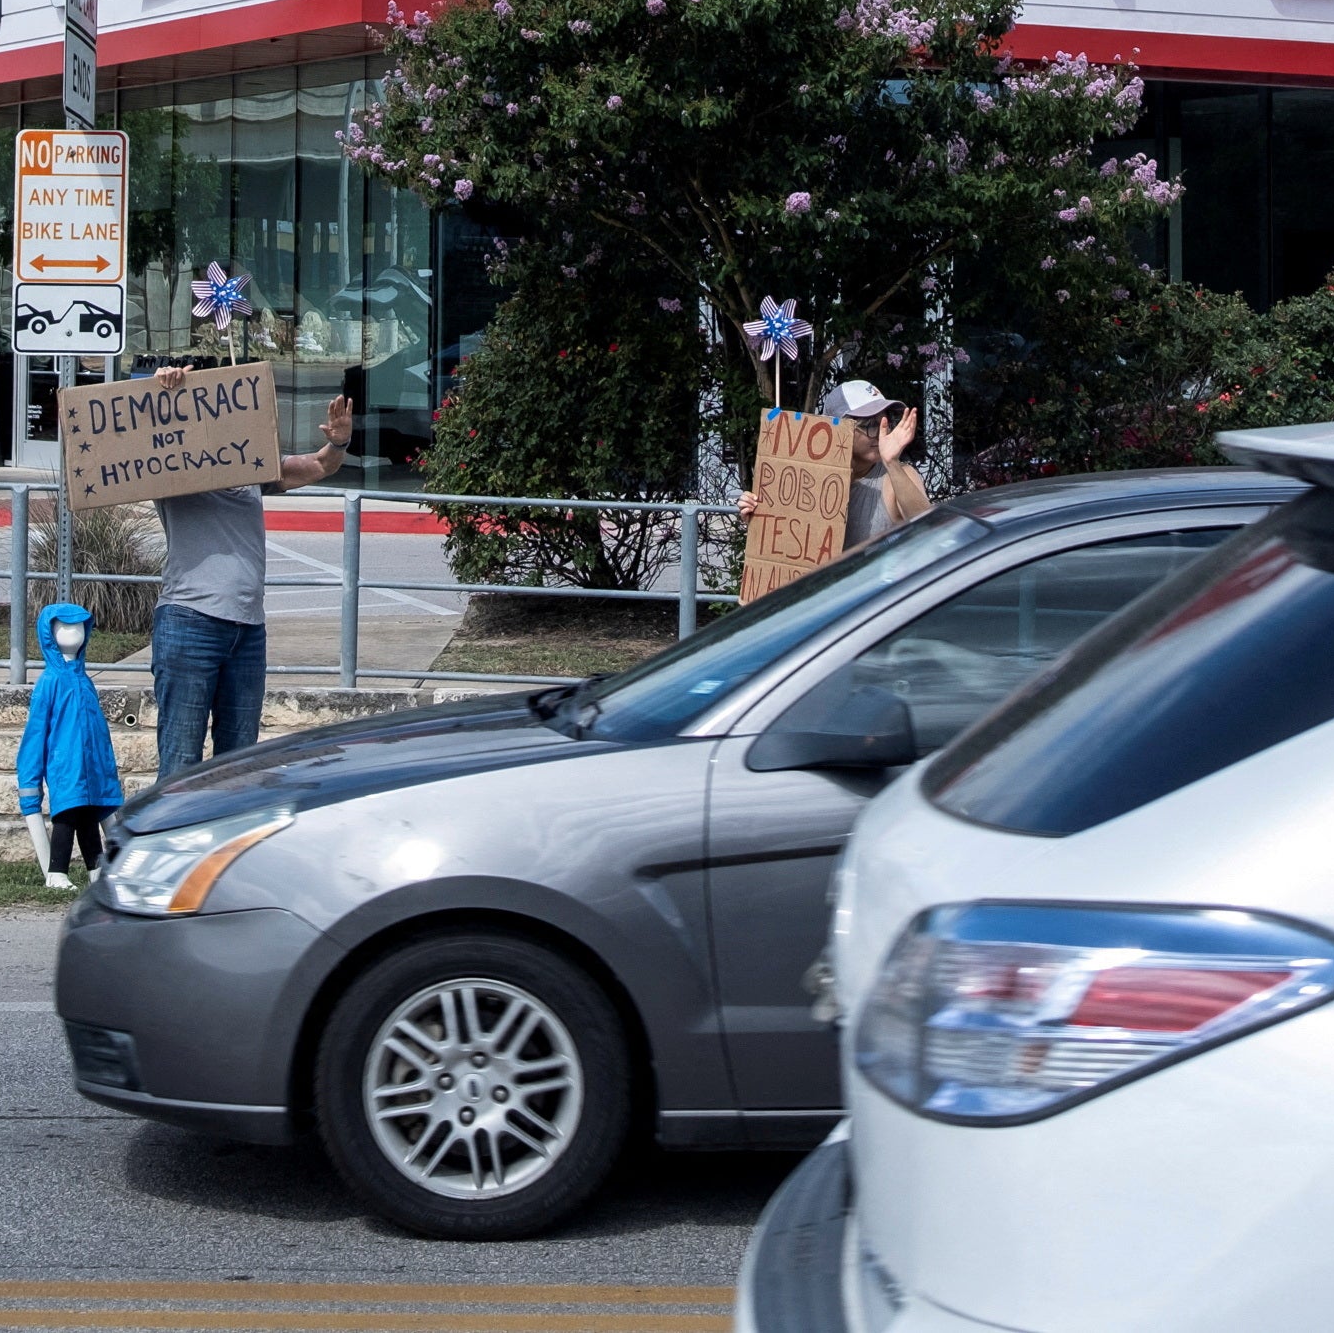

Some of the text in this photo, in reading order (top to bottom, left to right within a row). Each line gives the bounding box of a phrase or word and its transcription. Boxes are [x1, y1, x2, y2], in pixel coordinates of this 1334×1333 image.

[72, 52, 91, 103] ENDS
[22, 140, 120, 169] NO PARKING
[28, 188, 115, 207] ANY TIME
[22, 222, 119, 240] BIKE LANE
[88, 375, 261, 435] DEMOCRACY
[152, 429, 186, 449] NOT
[771, 411, 833, 461] NO
[100, 439, 250, 487] HYPOCRACY
[753, 513, 833, 565] TESLA
